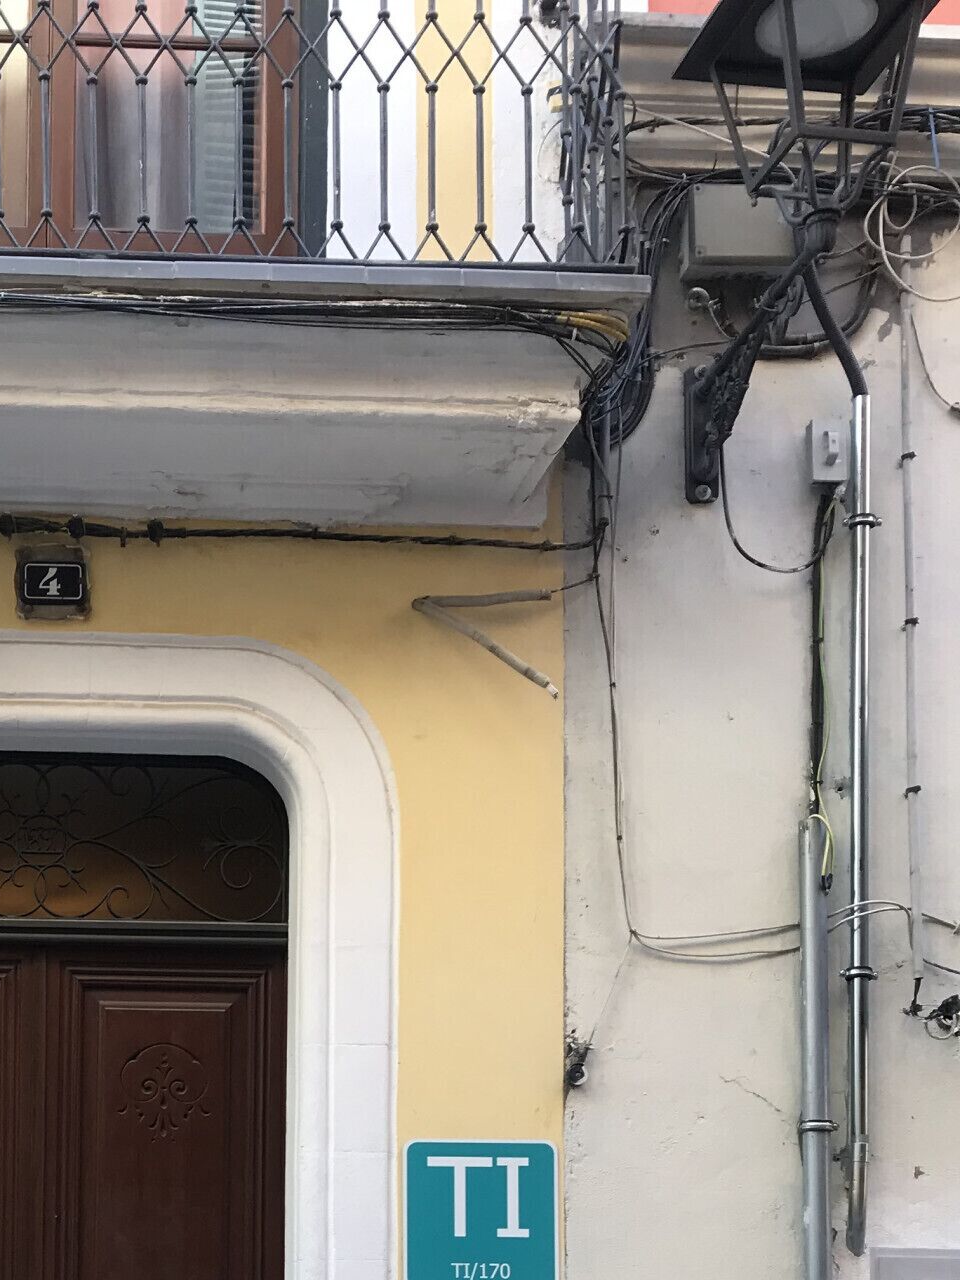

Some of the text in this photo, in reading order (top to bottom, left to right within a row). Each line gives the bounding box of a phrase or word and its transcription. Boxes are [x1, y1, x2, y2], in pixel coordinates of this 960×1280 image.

[38, 567, 61, 596] 4
[426, 1156, 530, 1238] TI
[451, 1262, 511, 1280] TI/170
